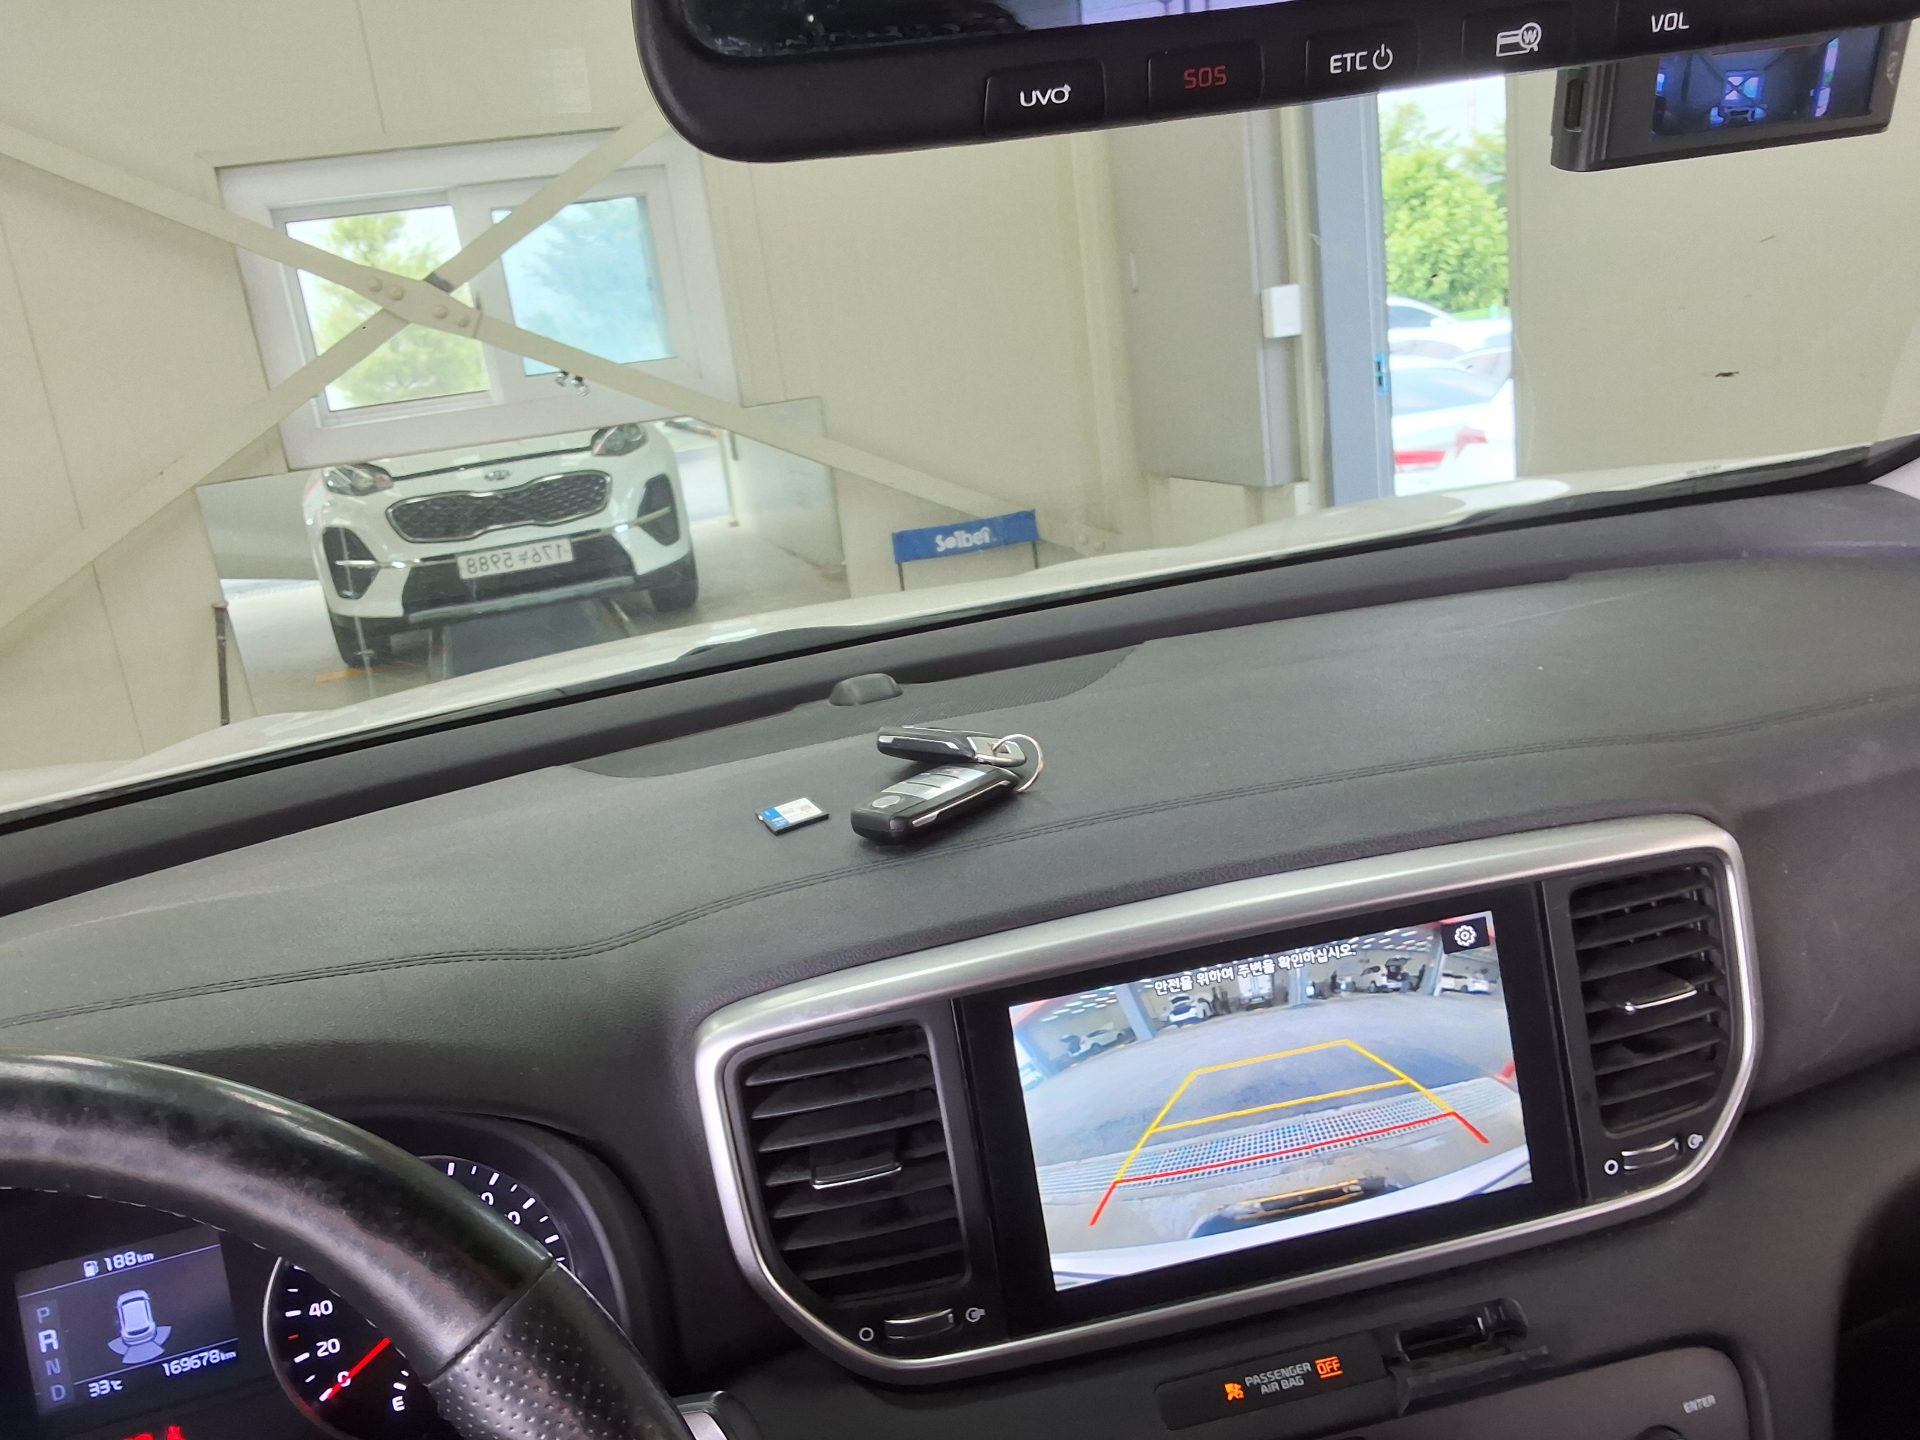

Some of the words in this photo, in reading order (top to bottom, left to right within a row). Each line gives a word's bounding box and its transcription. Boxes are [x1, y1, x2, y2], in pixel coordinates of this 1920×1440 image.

[1651, 12, 1690, 33] VOL
[1329, 51, 1368, 74] ETC
[1183, 65, 1228, 89] SOS
[1019, 84, 1072, 107] UVO
[1154, 975, 1193, 996] 안전을
[1196, 966, 1234, 987] 위하여
[1237, 958, 1275, 979] 주변을
[36, 1306, 50, 1323] P
[308, 1300, 334, 1317] 40
[38, 1329, 59, 1353] R
[315, 1338, 341, 1358] 20
[45, 1358, 61, 1376] N
[1244, 1362, 1312, 1388] PASSENGER
[1316, 1359, 1342, 1376] OFF
[51, 1384, 66, 1401] D
[1260, 1380, 1280, 1395] AIR
[1280, 1376, 1305, 1391] BAG
[391, 1395, 405, 1412] E
